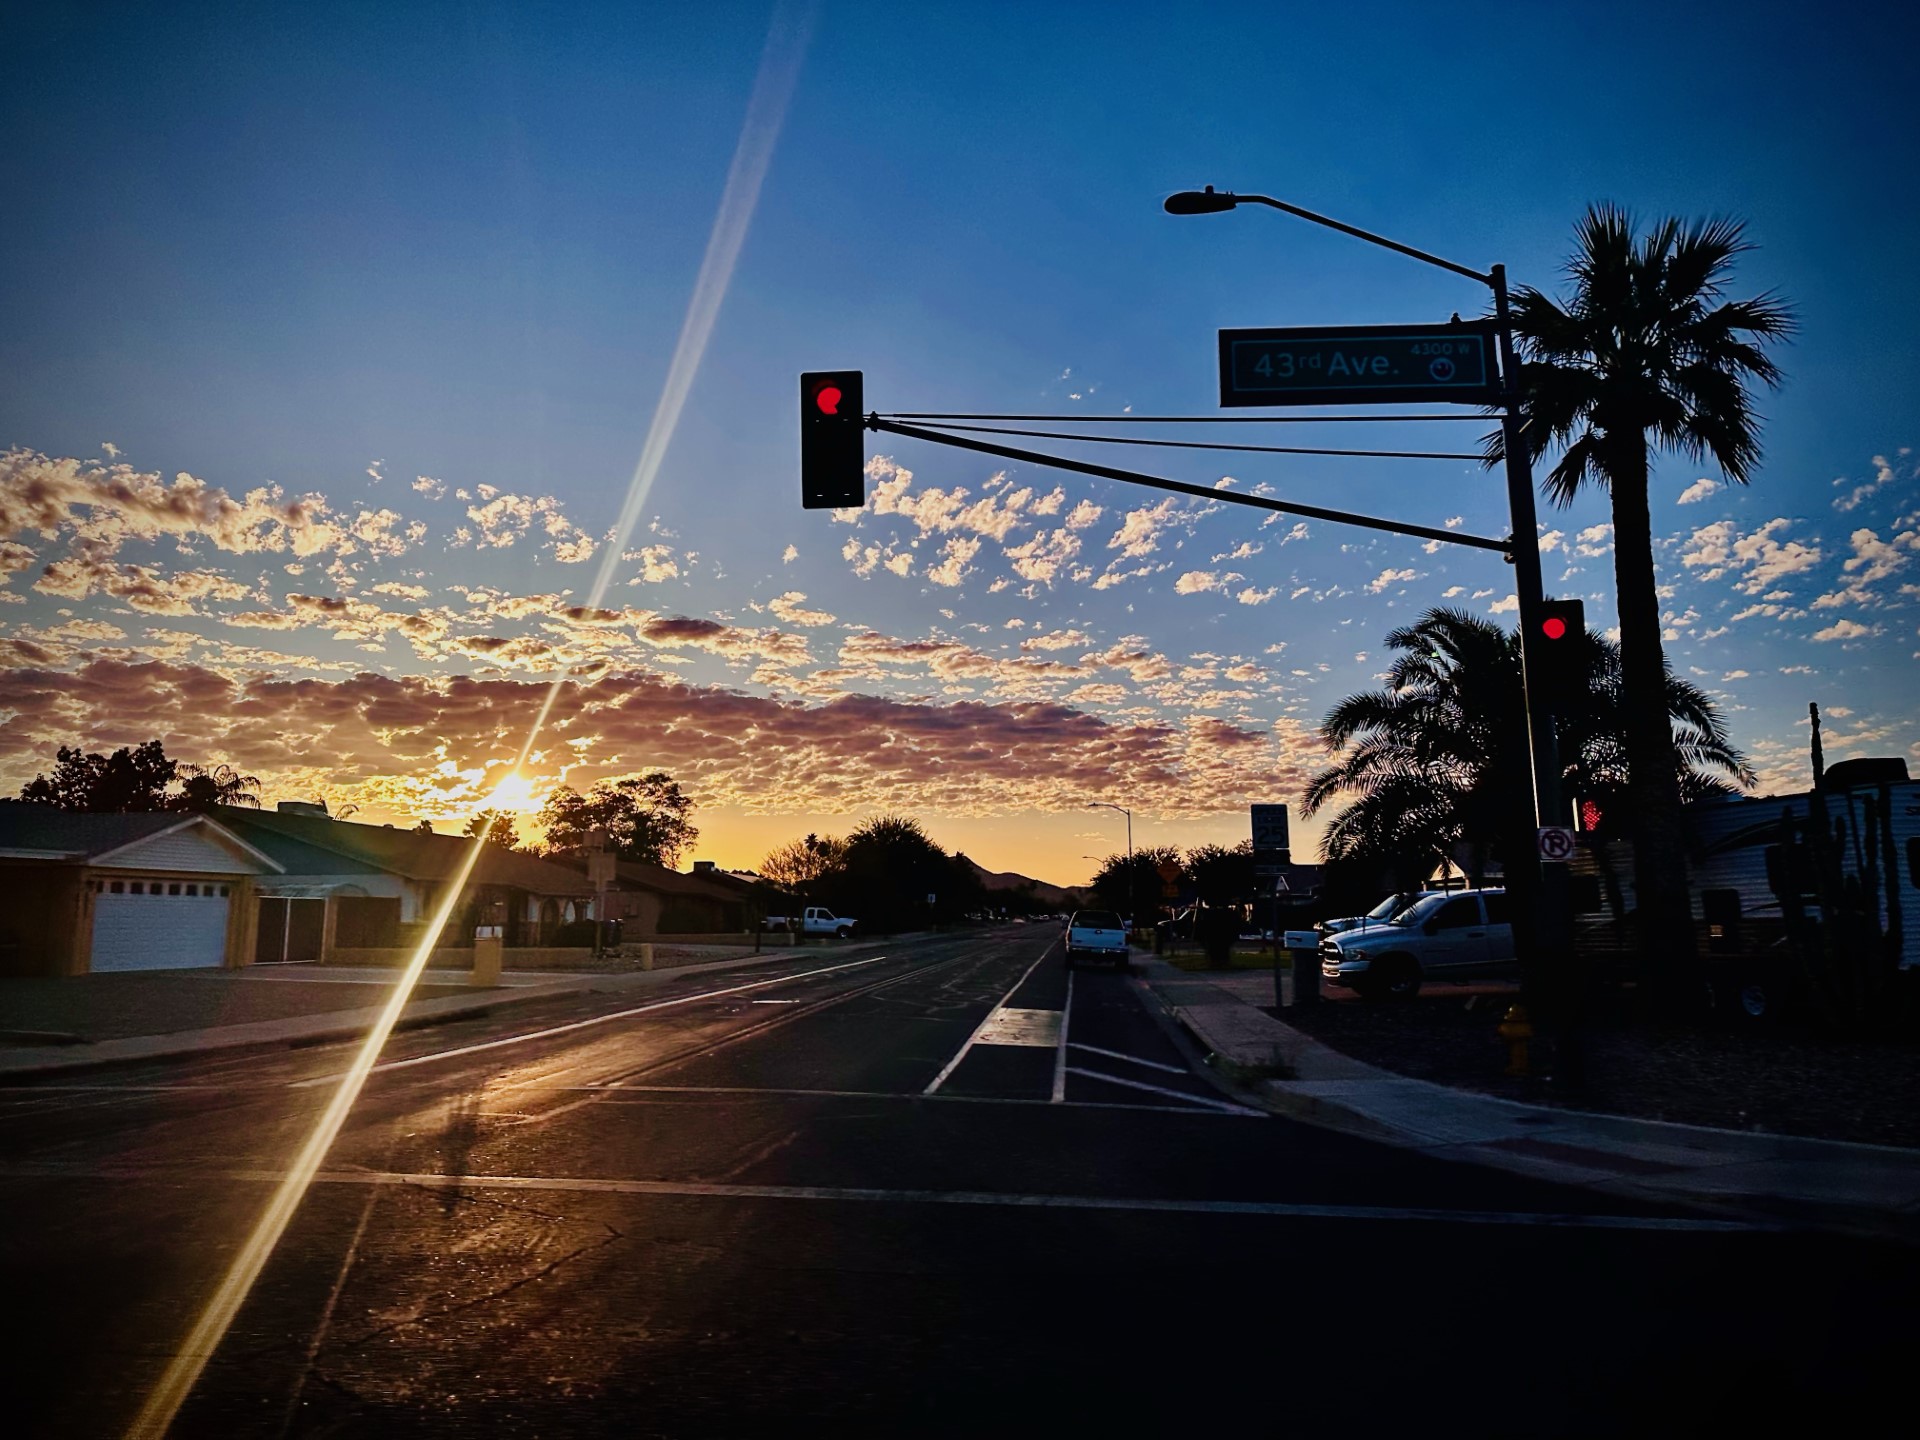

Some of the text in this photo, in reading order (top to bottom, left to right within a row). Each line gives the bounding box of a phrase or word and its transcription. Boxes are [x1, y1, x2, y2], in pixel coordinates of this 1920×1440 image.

[1410, 342, 1471, 355] 4300 W
[1253, 351, 1399, 378] 43rd Ave.
[1256, 826, 1284, 845] 25
